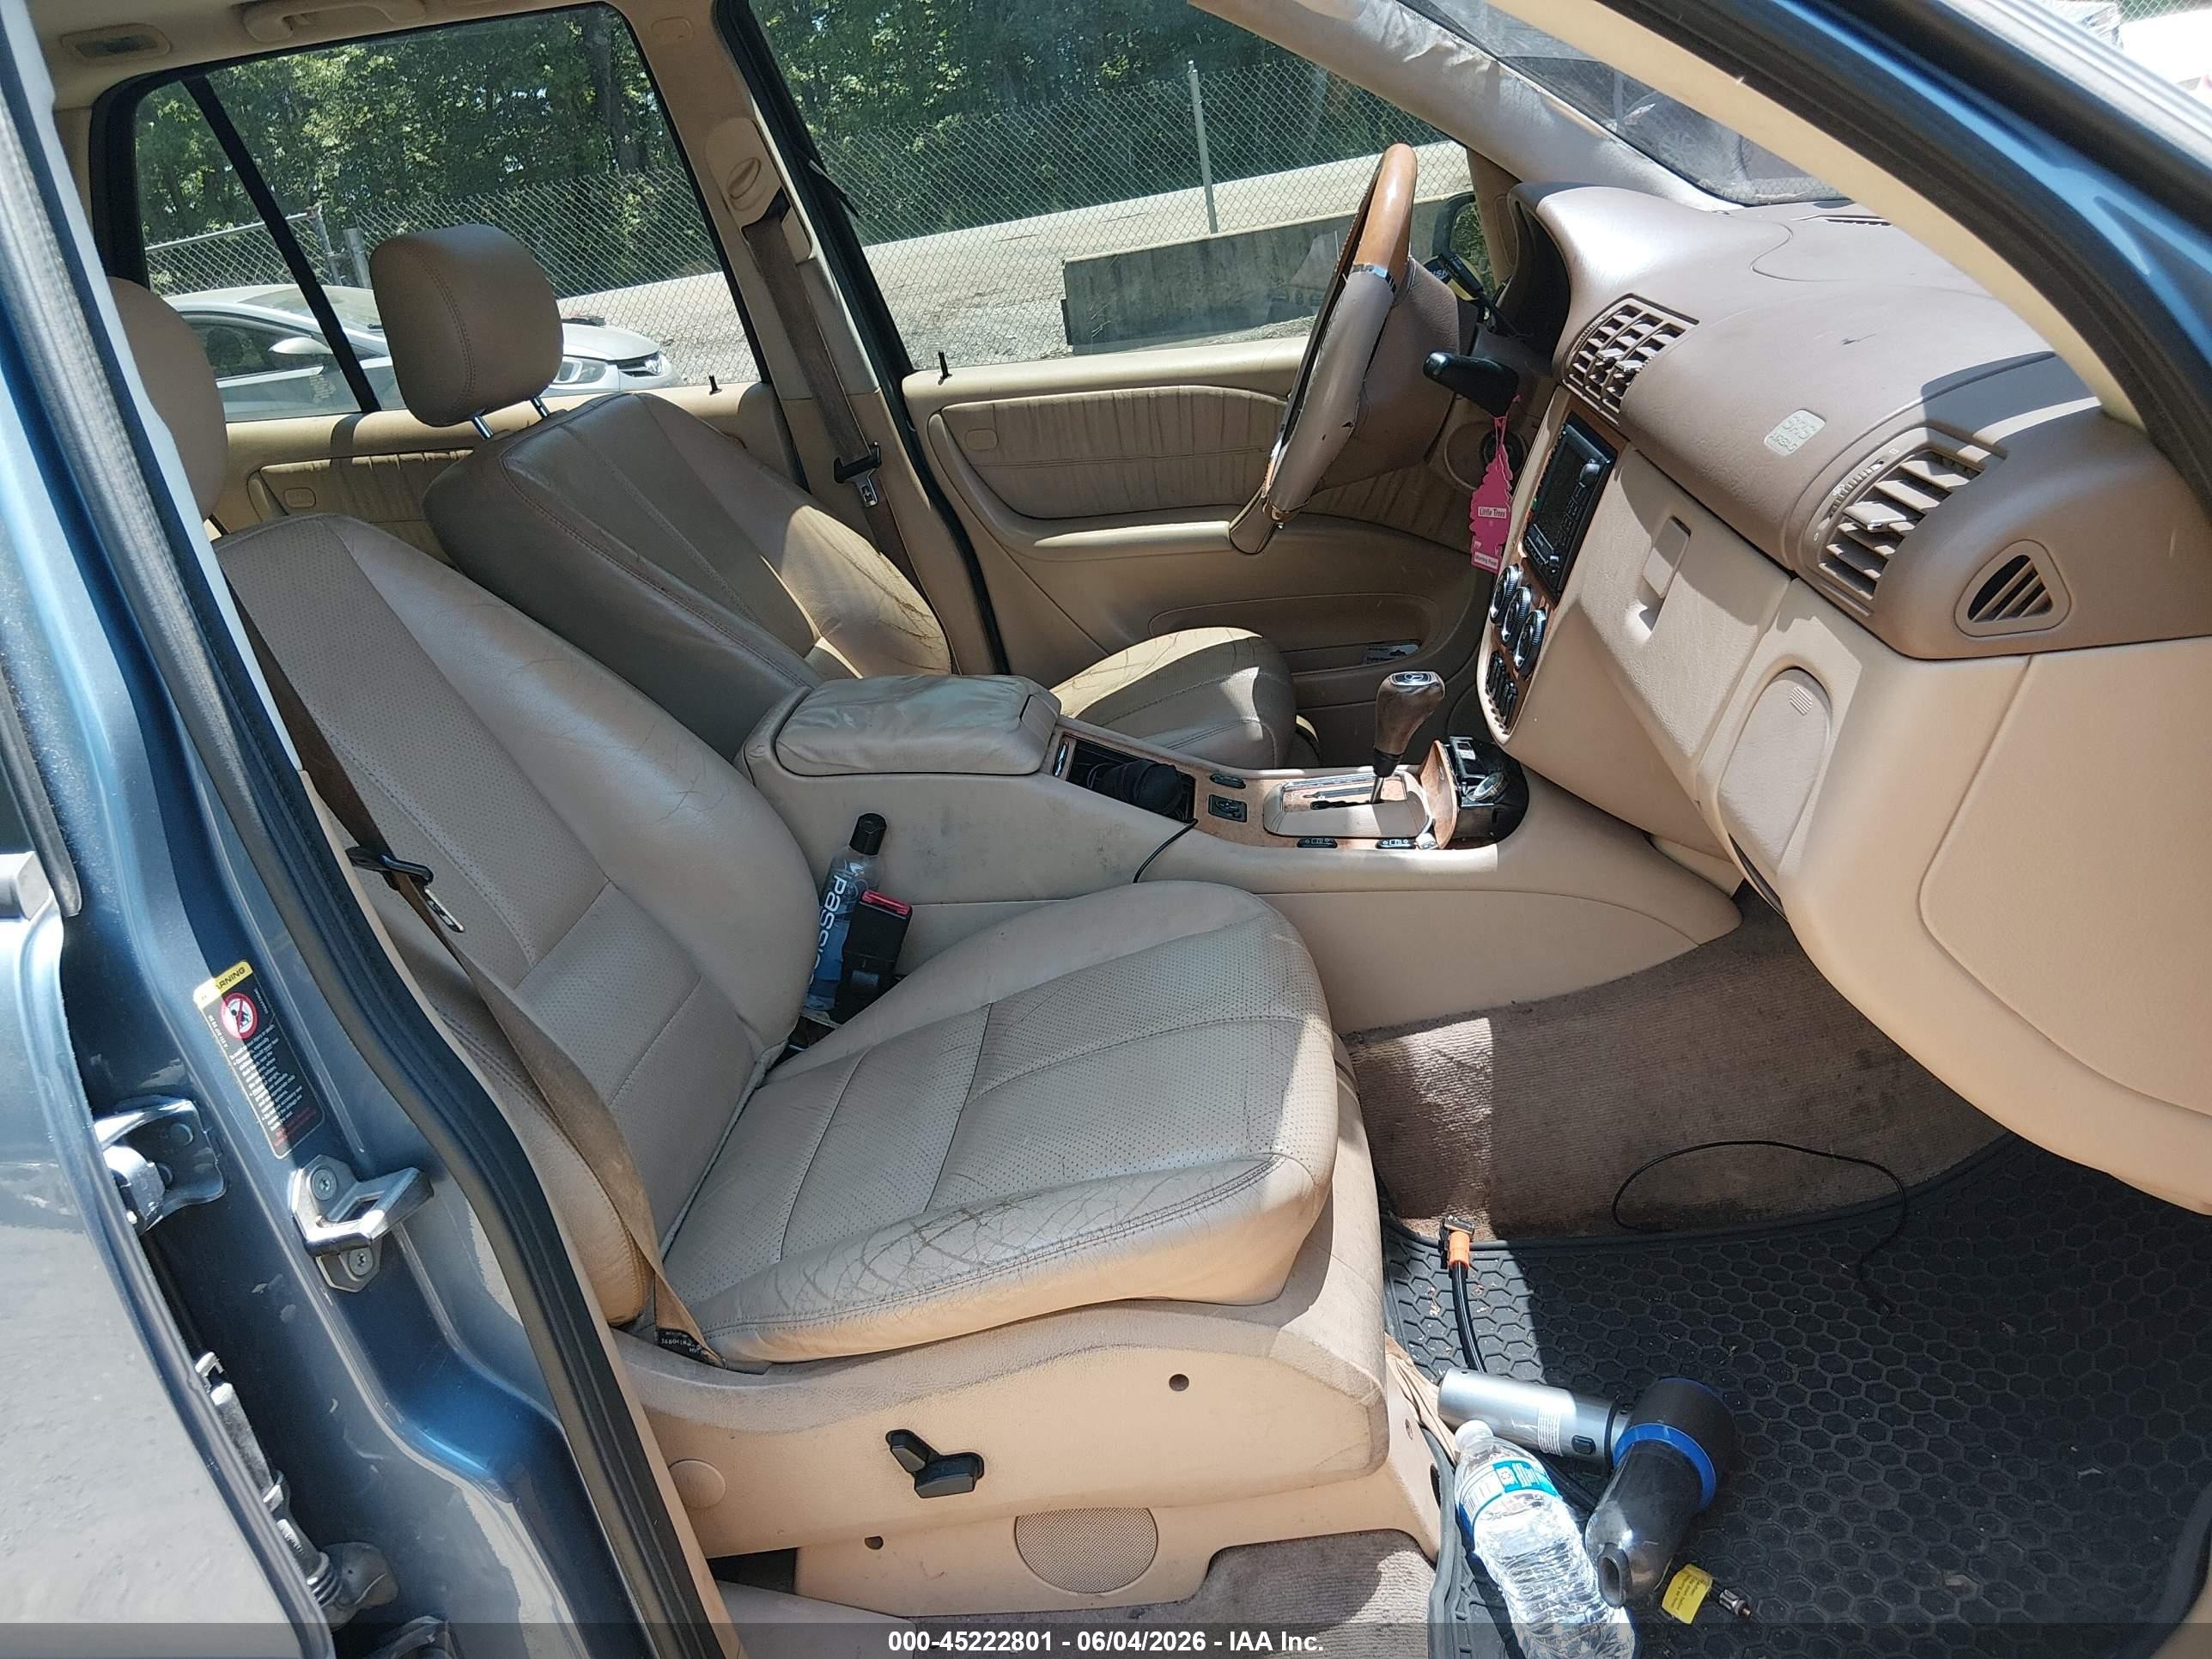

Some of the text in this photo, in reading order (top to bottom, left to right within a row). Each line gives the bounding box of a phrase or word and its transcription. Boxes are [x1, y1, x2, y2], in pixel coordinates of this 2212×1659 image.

[1480, 507, 1505, 517] Little Trees
[810, 874, 847, 985] Pass
[216, 965, 246, 991] RNING
